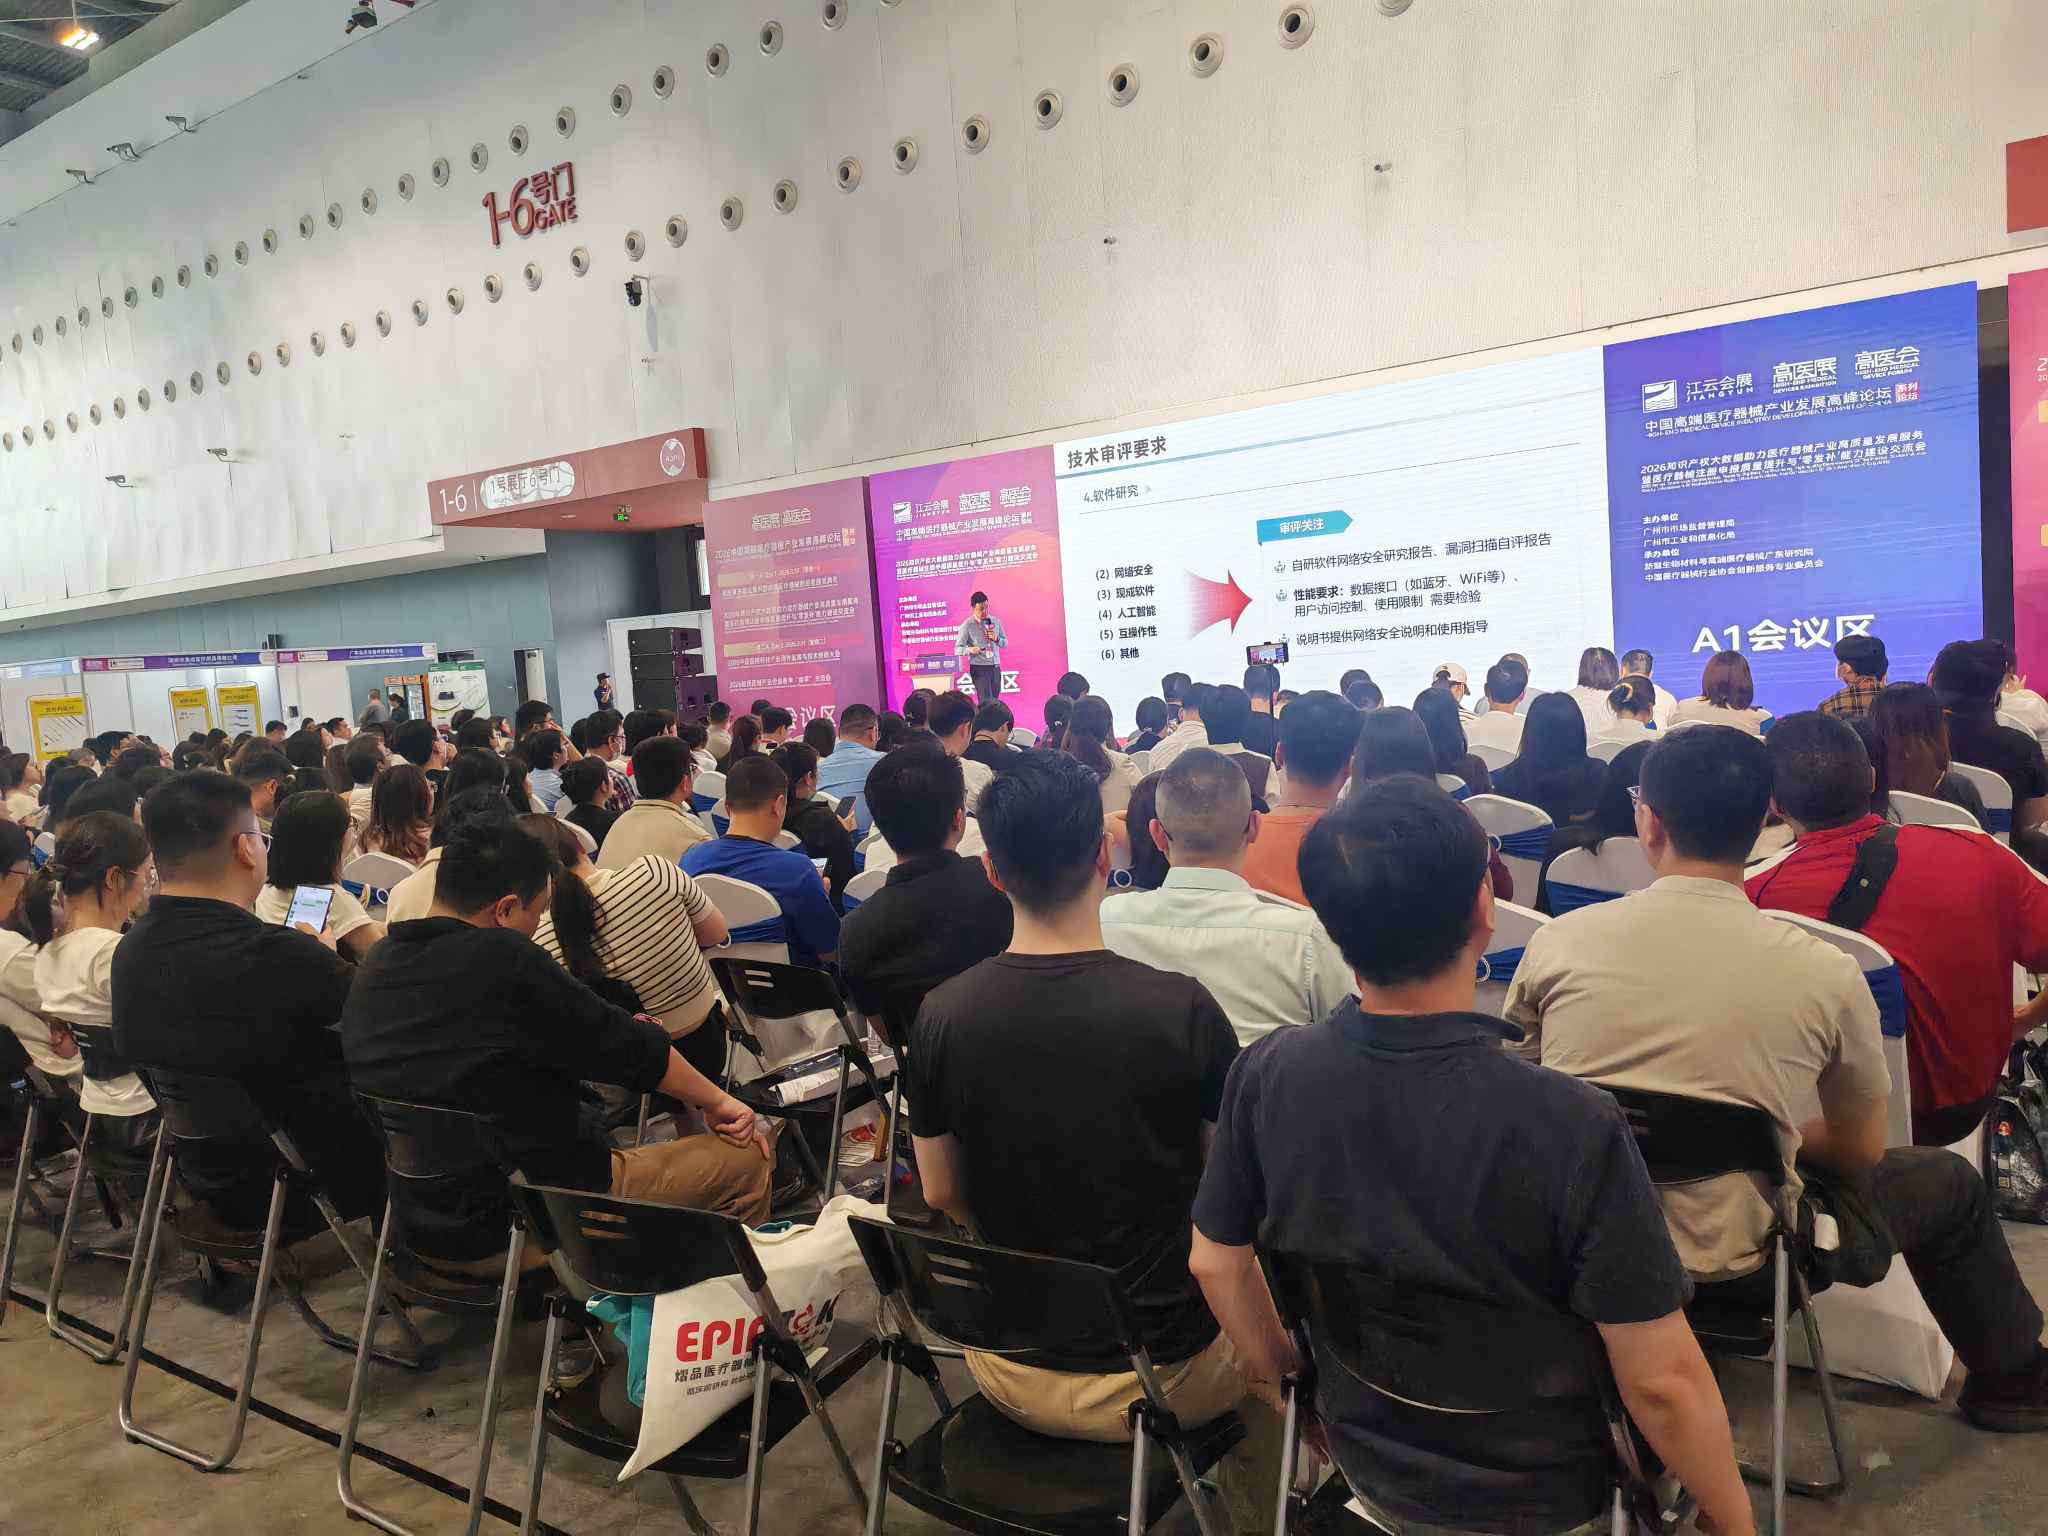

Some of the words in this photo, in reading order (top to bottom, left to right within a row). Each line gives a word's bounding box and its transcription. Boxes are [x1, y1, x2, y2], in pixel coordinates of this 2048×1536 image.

[535, 198, 578, 230] GATE
[1686, 373, 1752, 395] 江云会展
[1646, 387, 1892, 432] 中国高端医疗器械产业发展高峰论坛
[1067, 436, 1167, 469] 技术审评要求
[490, 466, 560, 493] 1号展厅6号门
[1083, 484, 1139, 503] 4.软件研究
[439, 484, 467, 514] 1-6
[1280, 518, 1325, 534] 审评关注
[1292, 532, 1552, 572] 自研软件网络安全研究报告、漏洞扫描自评报告
[1430, 589, 1481, 607] 需要检验
[1296, 619, 1489, 646] 说明书提供网络安全说明和使用指导
[1692, 614, 1875, 653] A1会议区
